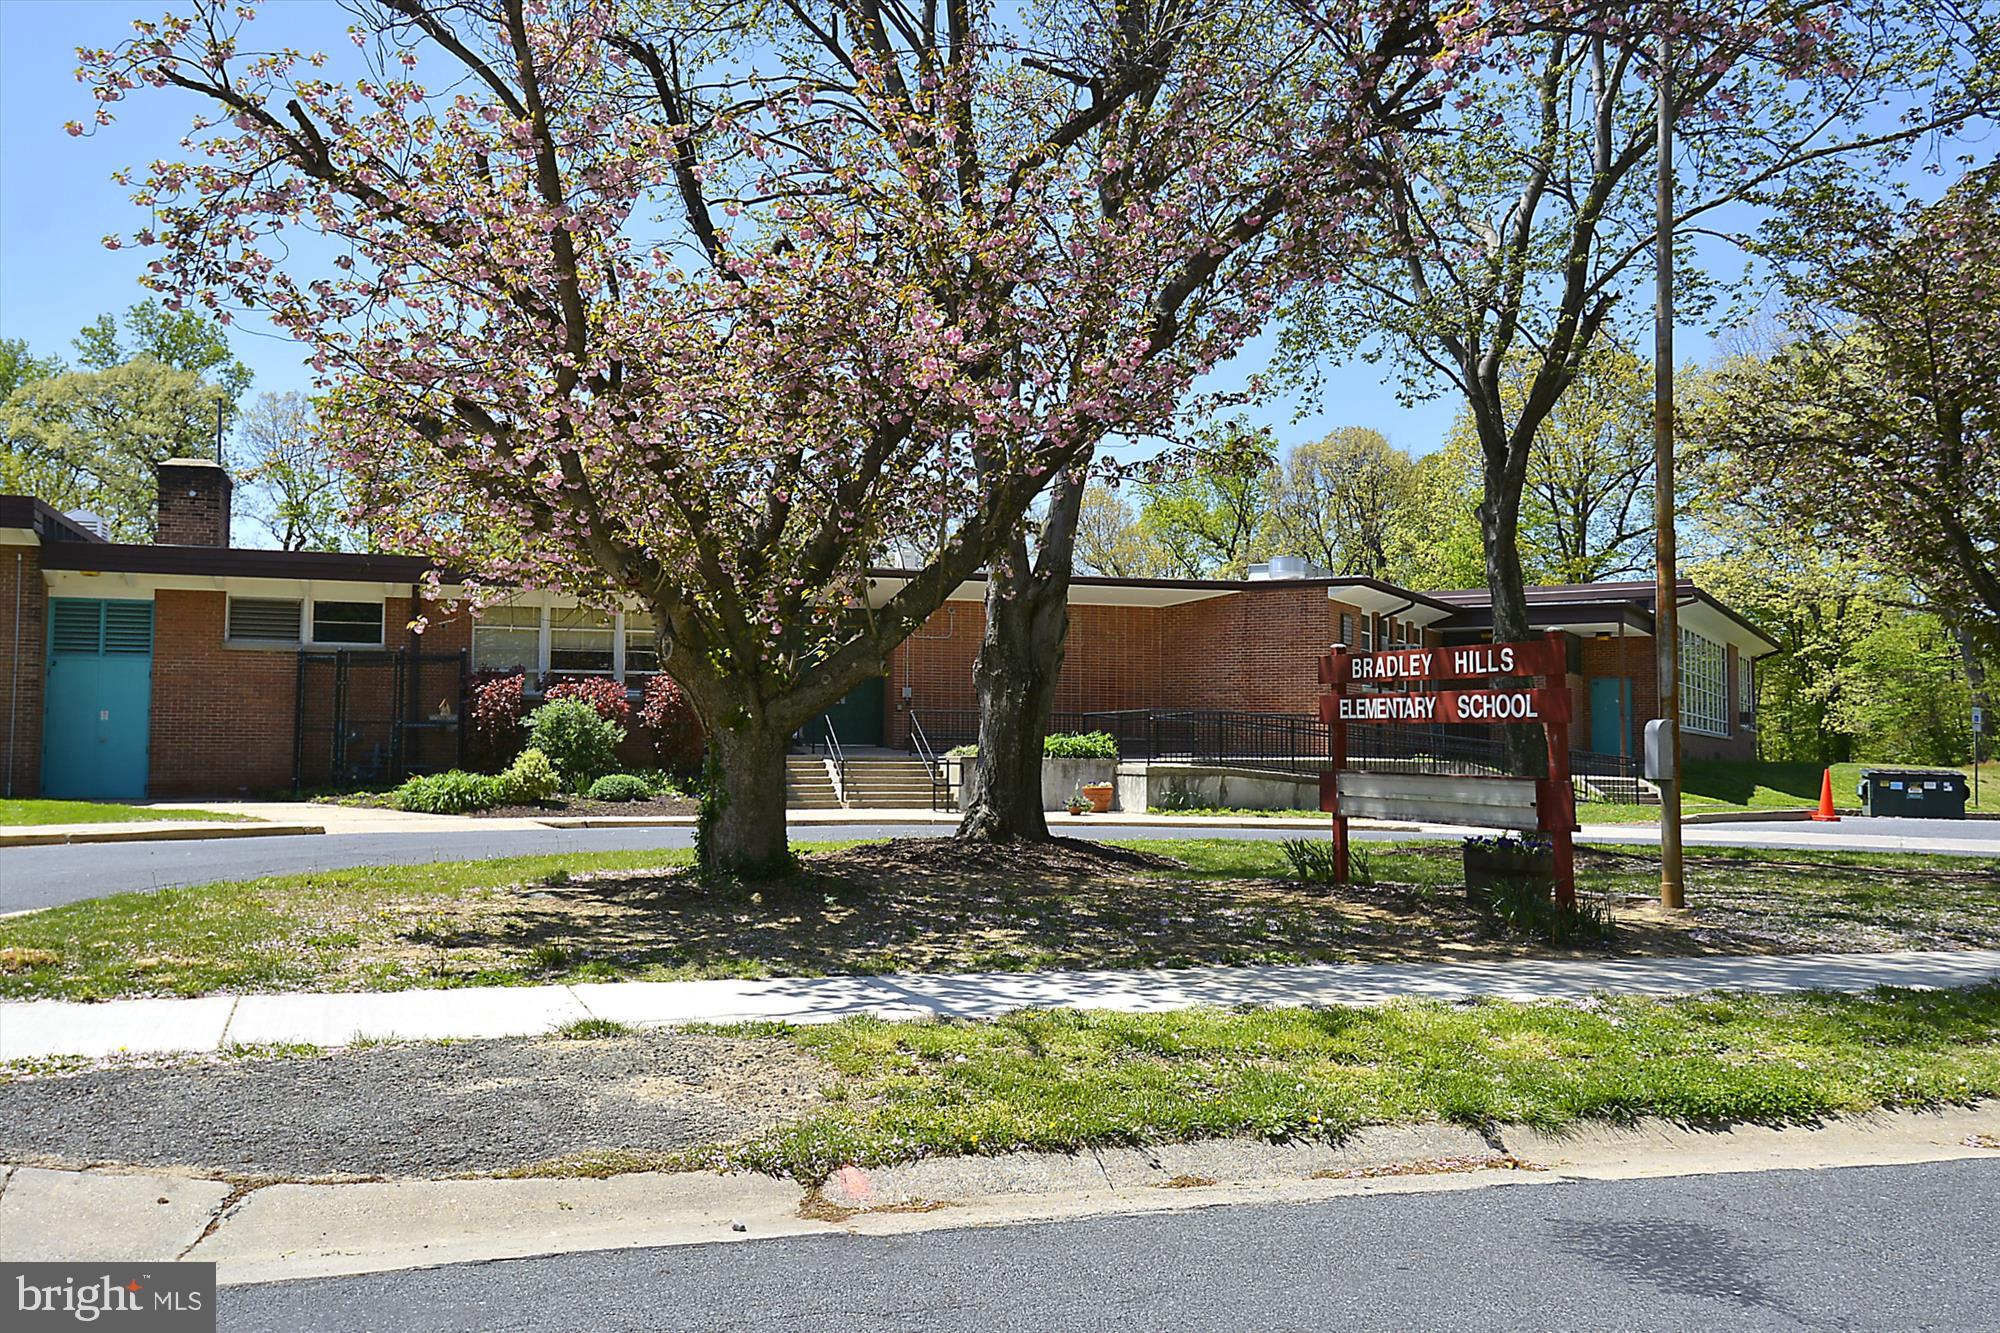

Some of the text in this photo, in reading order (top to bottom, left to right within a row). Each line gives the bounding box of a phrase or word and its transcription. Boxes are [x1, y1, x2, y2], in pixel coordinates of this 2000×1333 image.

[1351, 648, 1514, 679] BRADLEY HILLS
[1339, 693, 1538, 719] ELEMENTARY SCHOOL
